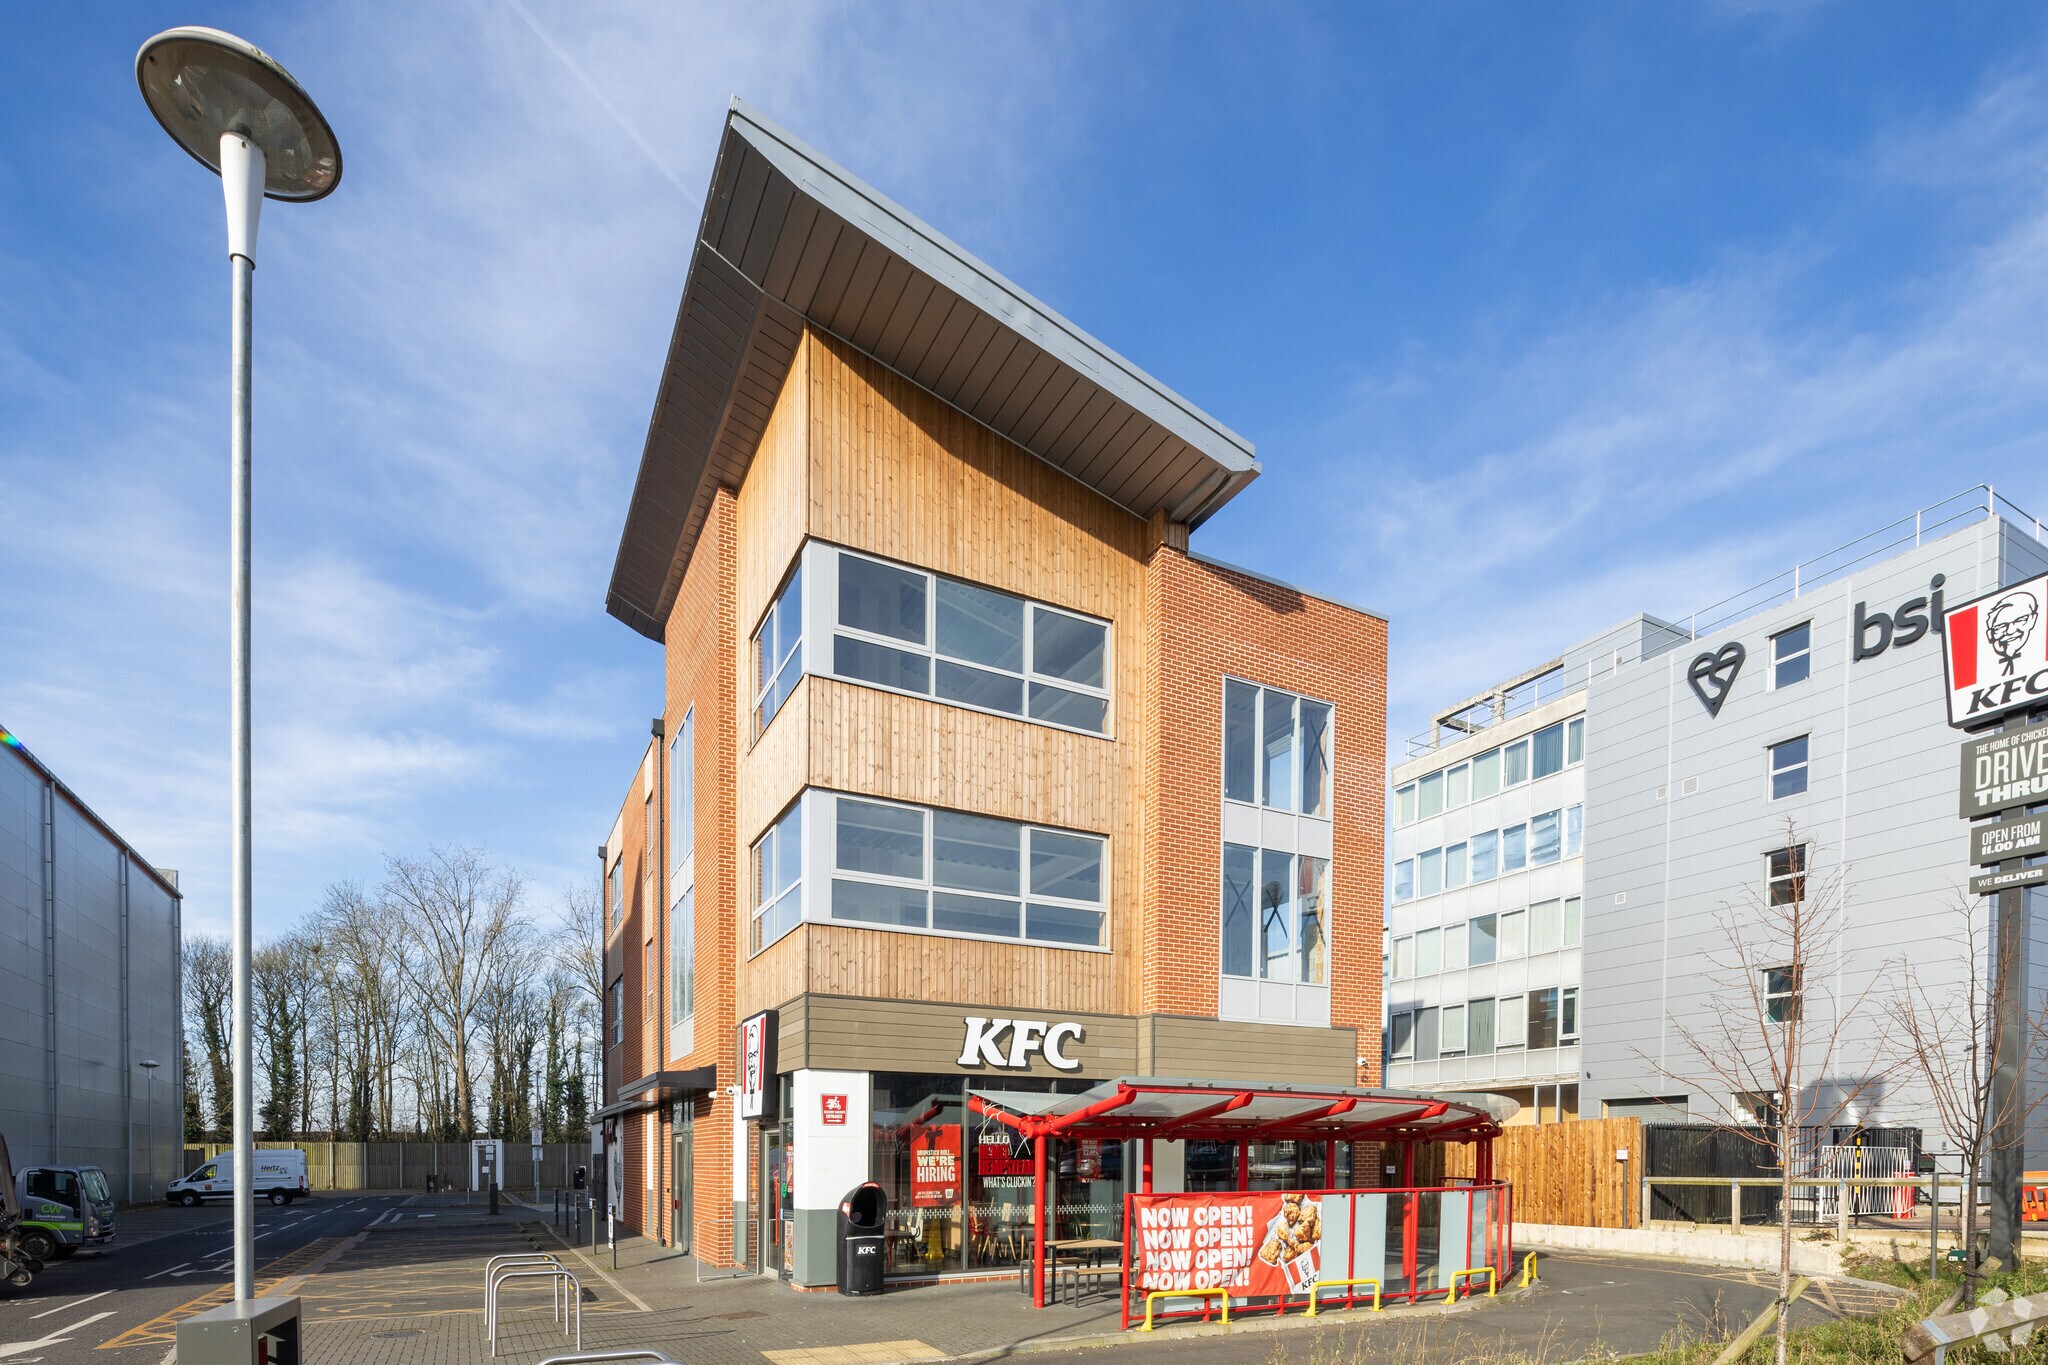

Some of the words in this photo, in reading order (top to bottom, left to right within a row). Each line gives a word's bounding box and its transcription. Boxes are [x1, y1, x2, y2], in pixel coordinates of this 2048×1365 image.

[1853, 572, 1946, 662] bsi
[1966, 667, 2048, 715] KFC
[1976, 743, 1989, 755] THE
[1990, 737, 2010, 752] HOME
[2011, 734, 2020, 746] OF
[1976, 739, 2048, 790] DRIVE
[1974, 774, 2048, 807] THRU
[1982, 827, 2009, 846] OPEN
[2011, 820, 2041, 840] FROM
[1981, 841, 2013, 856] 11.00
[2015, 835, 2041, 849] AM
[1978, 877, 1993, 887] WE
[1994, 869, 2043, 885] DELIVER
[957, 1016, 1082, 1069] KFC
[979, 1135, 1009, 1144] HELLO
[917, 1155, 955, 1166] WE'RE
[917, 1166, 956, 1182] HIRING
[983, 1176, 1006, 1188] WHAT'S
[41, 1204, 62, 1214] CW
[1141, 1207, 1189, 1228] NOW
[1193, 1206, 1253, 1227] OPEN!
[1143, 1229, 1191, 1250] NOW
[1195, 1227, 1253, 1248] OPEN!
[857, 1246, 876, 1255] KFC
[1146, 1250, 1191, 1271] NOW
[1195, 1247, 1253, 1269] OPEN!
[1142, 1270, 1191, 1290] NOW
[1194, 1267, 1250, 1289] OPEN!
[1301, 1274, 1319, 1291] KFC
